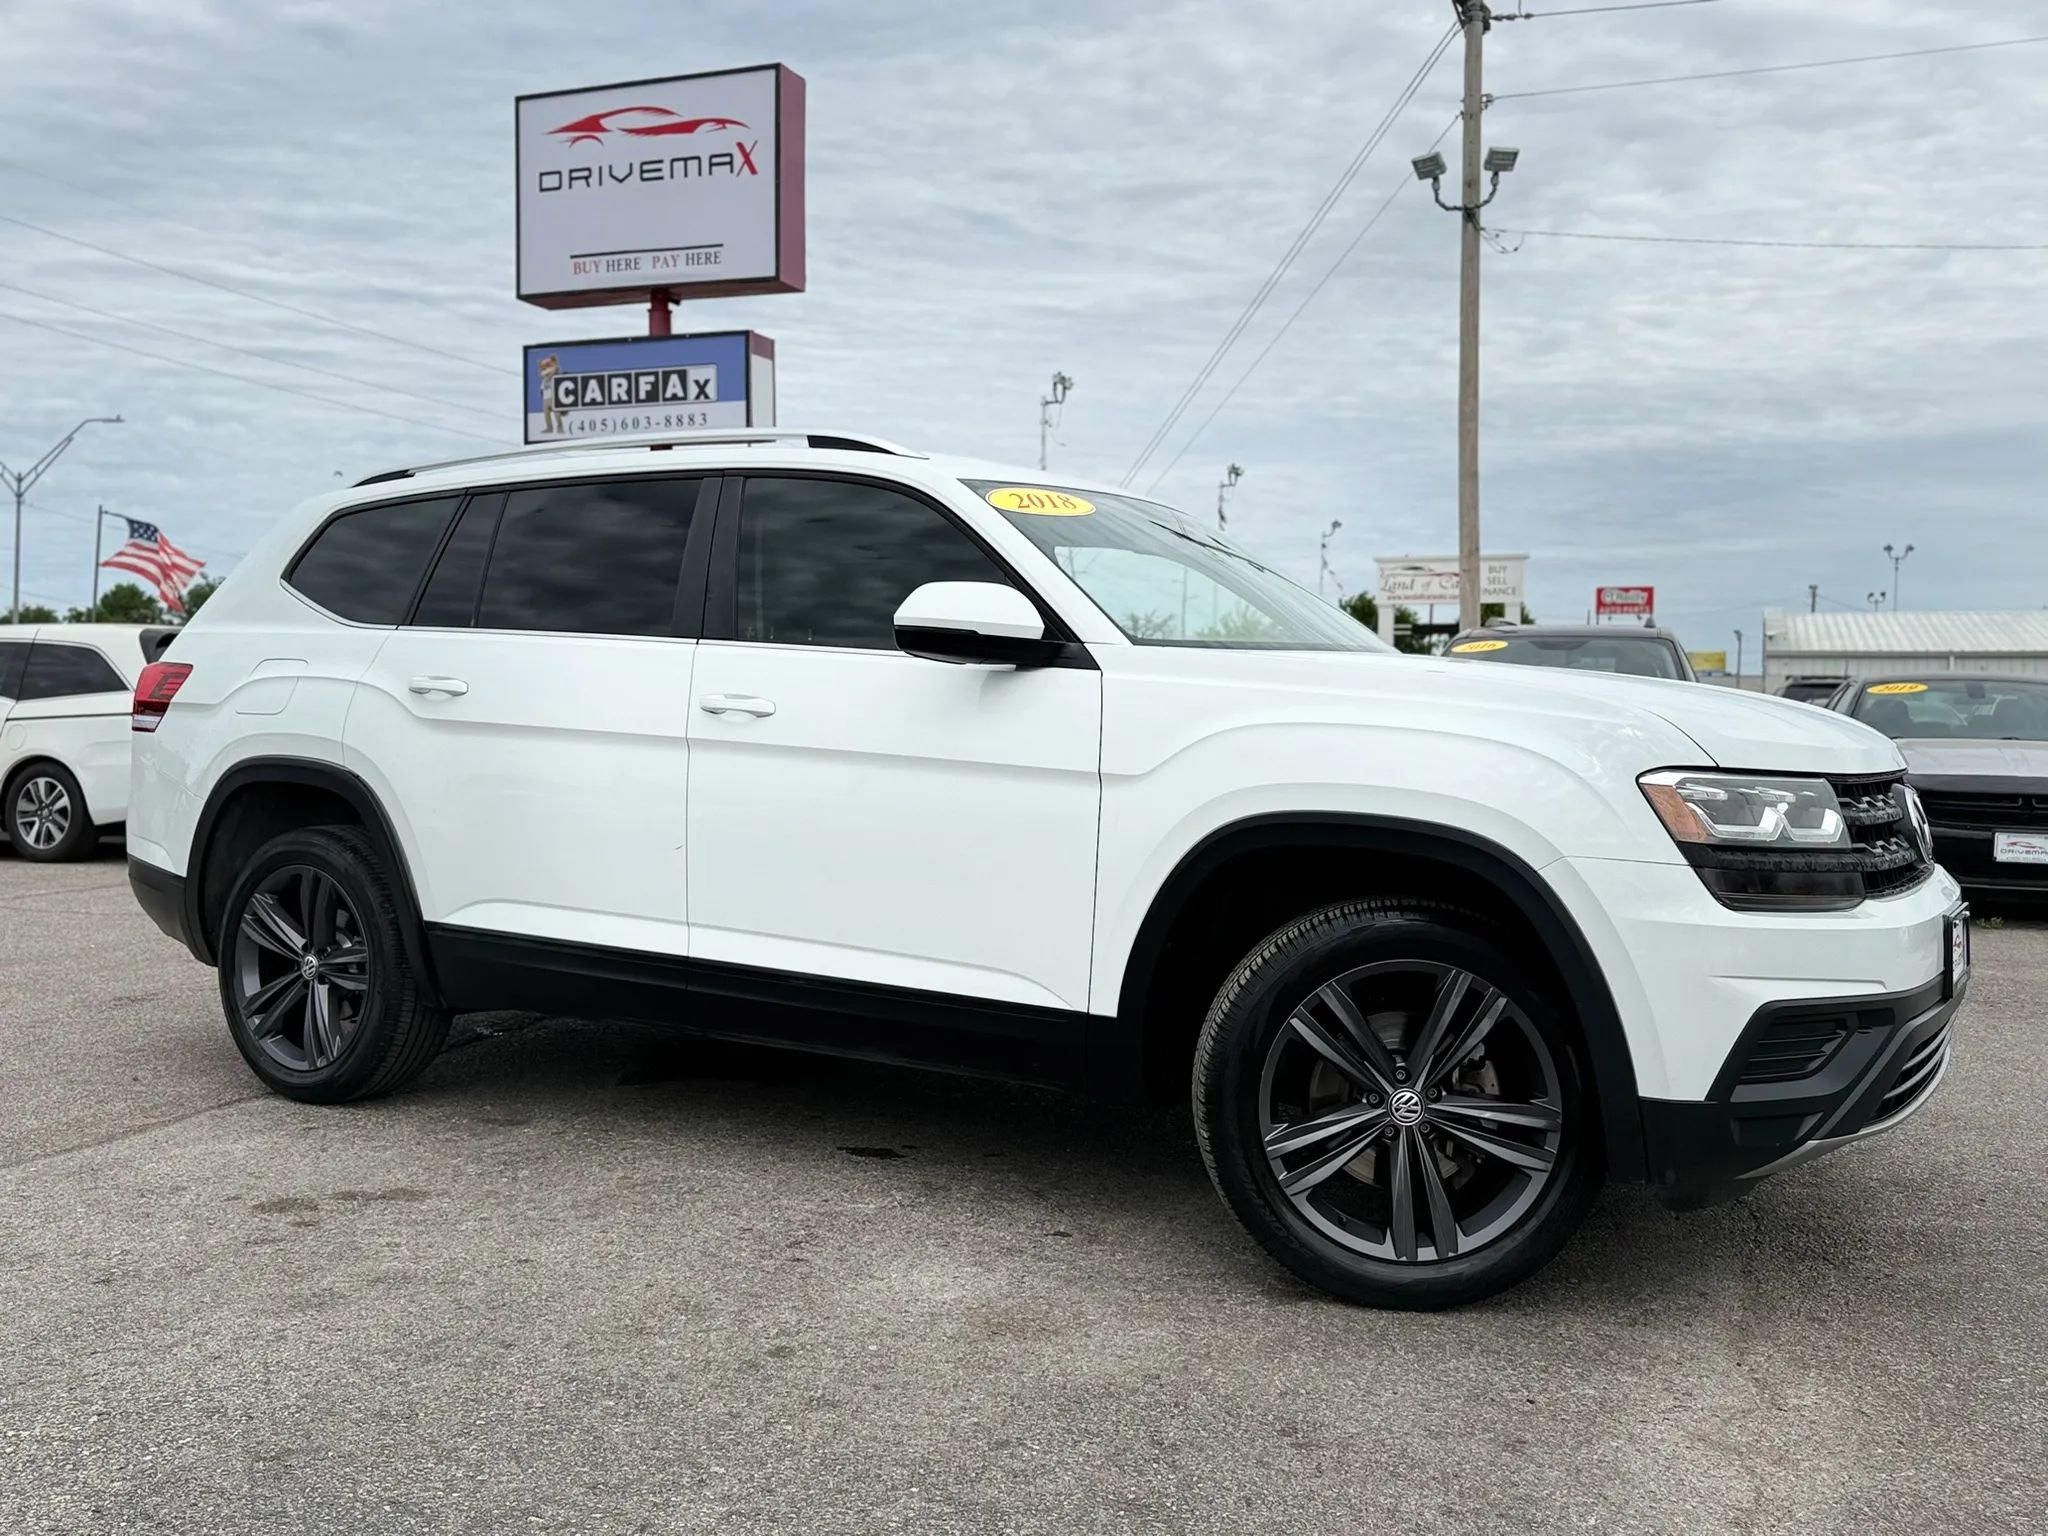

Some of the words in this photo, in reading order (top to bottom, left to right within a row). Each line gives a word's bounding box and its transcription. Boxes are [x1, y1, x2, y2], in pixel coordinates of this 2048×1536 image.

[538, 140, 759, 193] DRIVEMAX
[572, 260, 602, 276] BUY
[605, 256, 642, 273] HERE
[651, 253, 681, 269] PAY
[685, 250, 723, 267] HERE
[568, 412, 708, 436] (405)603-8883
[1008, 492, 1078, 510] 2018
[1487, 565, 1508, 574] BUY
[1380, 578, 1416, 594] Land
[1438, 576, 1460, 592] Ca
[1487, 576, 1508, 586] SELL
[1483, 586, 1517, 596] NANCE
